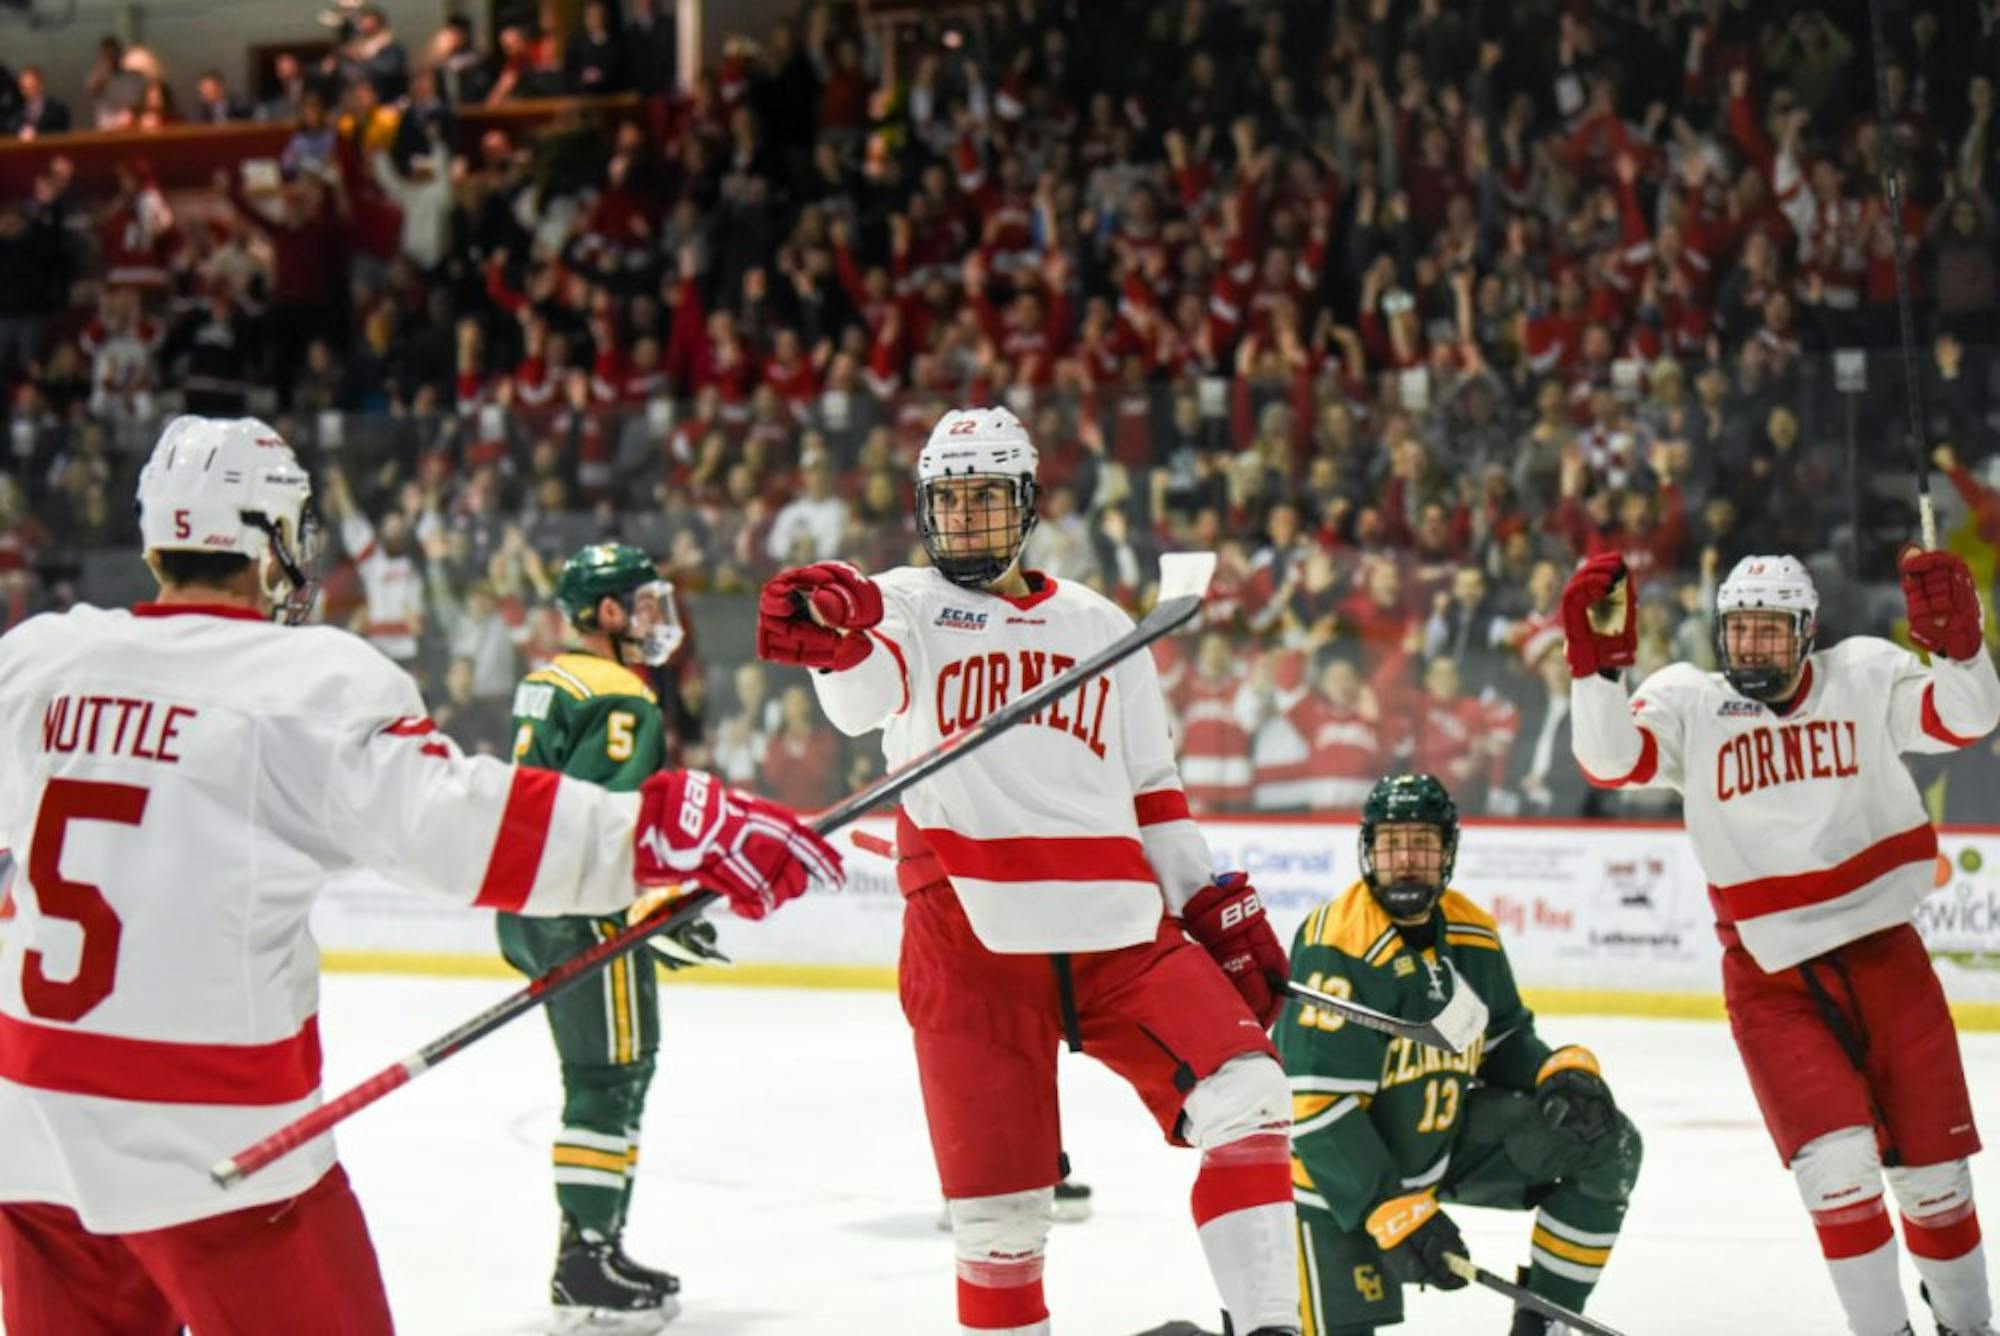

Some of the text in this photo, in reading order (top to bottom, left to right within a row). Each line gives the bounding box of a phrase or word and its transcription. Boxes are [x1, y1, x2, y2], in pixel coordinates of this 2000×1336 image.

[949, 419, 977, 436] 22
[174, 508, 192, 540] 5
[941, 607, 988, 623] ECAC
[607, 710, 636, 762] 5
[1717, 719, 1859, 802] CORNELL
[20, 777, 151, 1024] 5
[1298, 971, 1352, 1033] 13
[1417, 1077, 1459, 1133] 13
